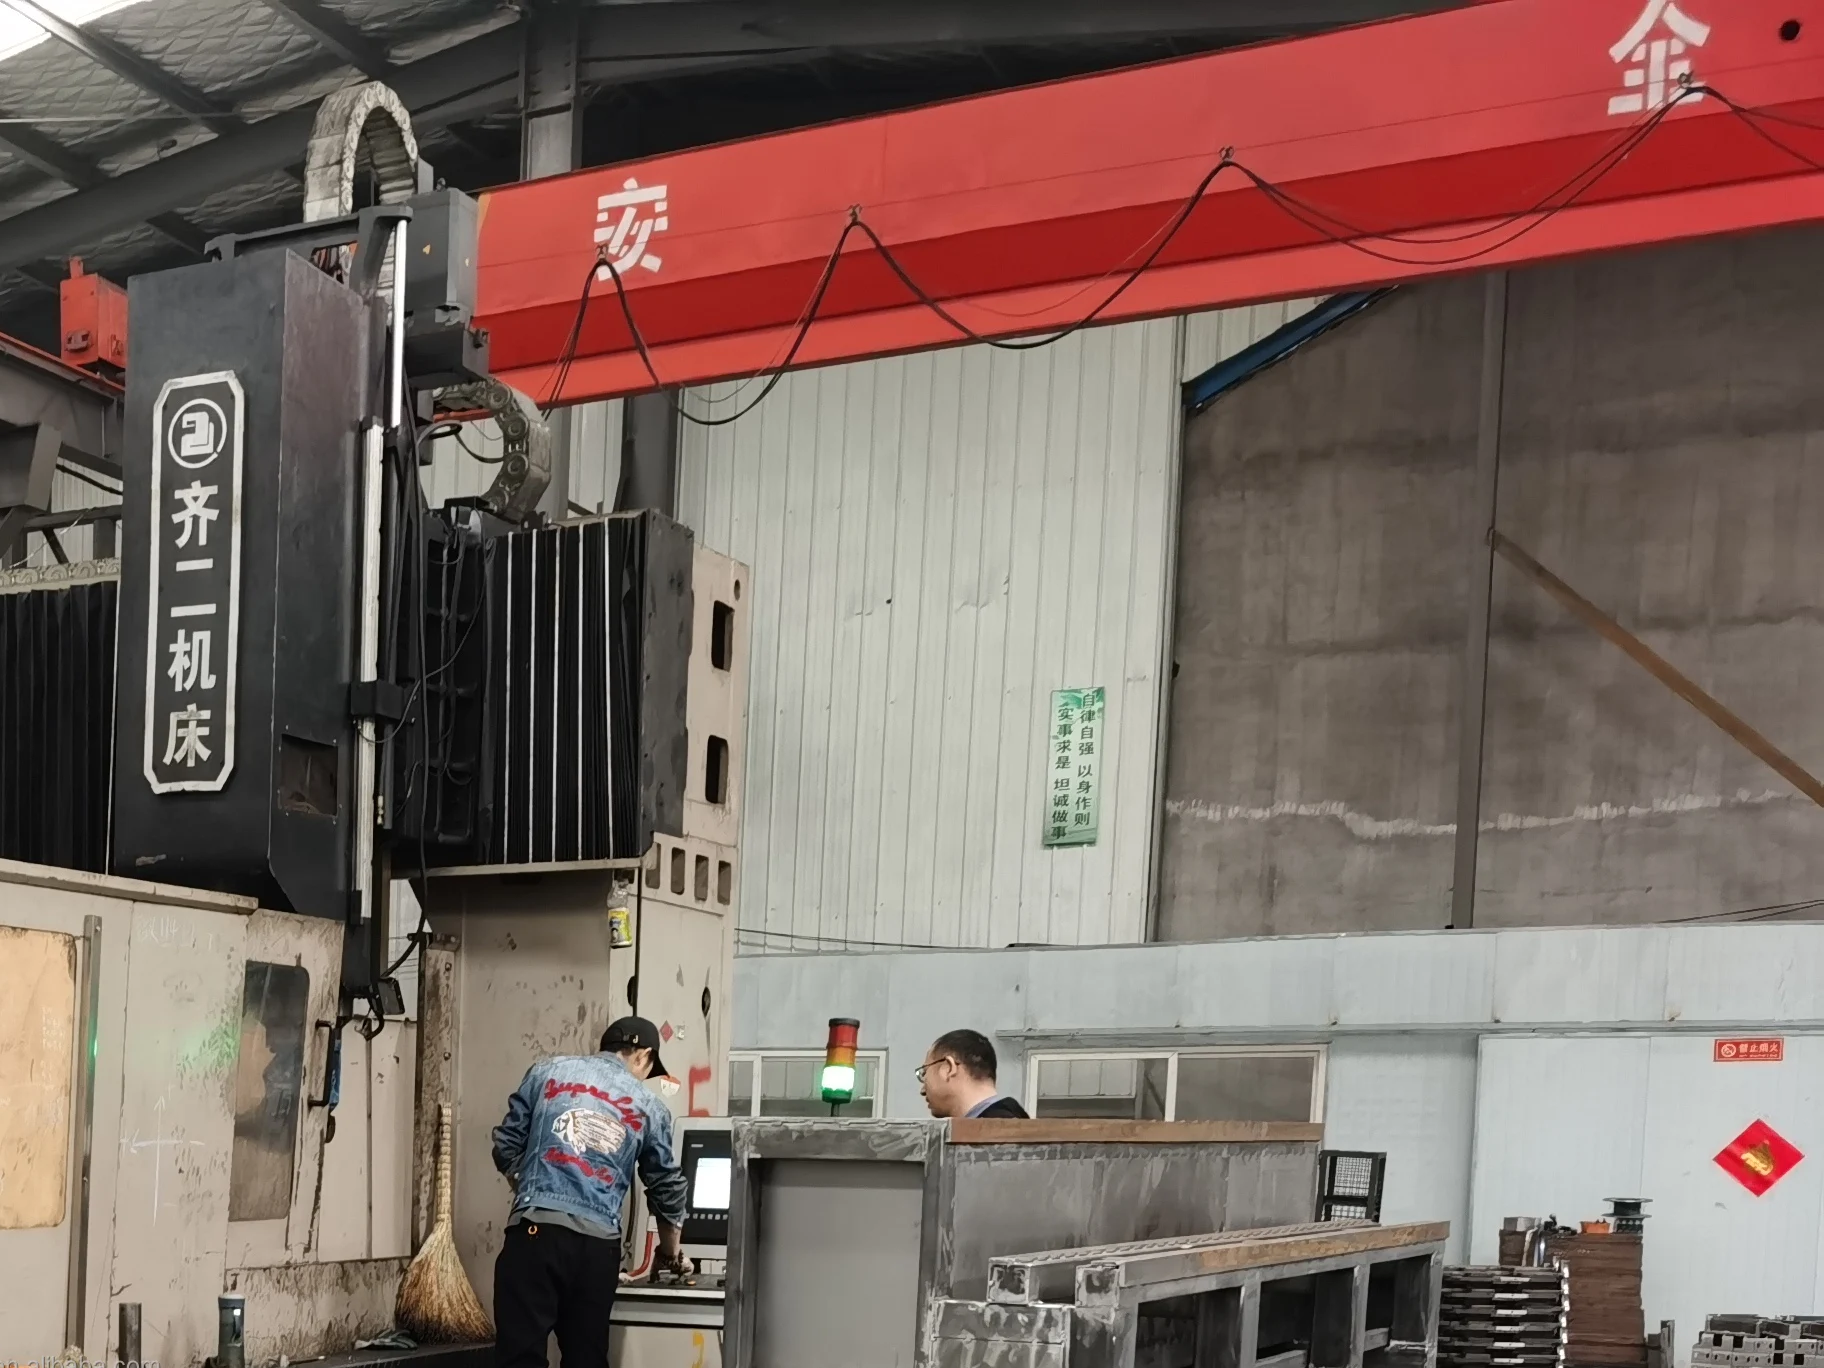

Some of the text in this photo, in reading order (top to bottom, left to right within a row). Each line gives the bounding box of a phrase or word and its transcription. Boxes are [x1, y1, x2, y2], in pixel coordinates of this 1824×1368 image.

[594, 177, 668, 282] 安
[162, 480, 220, 768] 齐二机床
[1050, 706, 1074, 840] 实事求是 坦诚做事
[1074, 693, 1096, 827] 自律自强 以身作则
